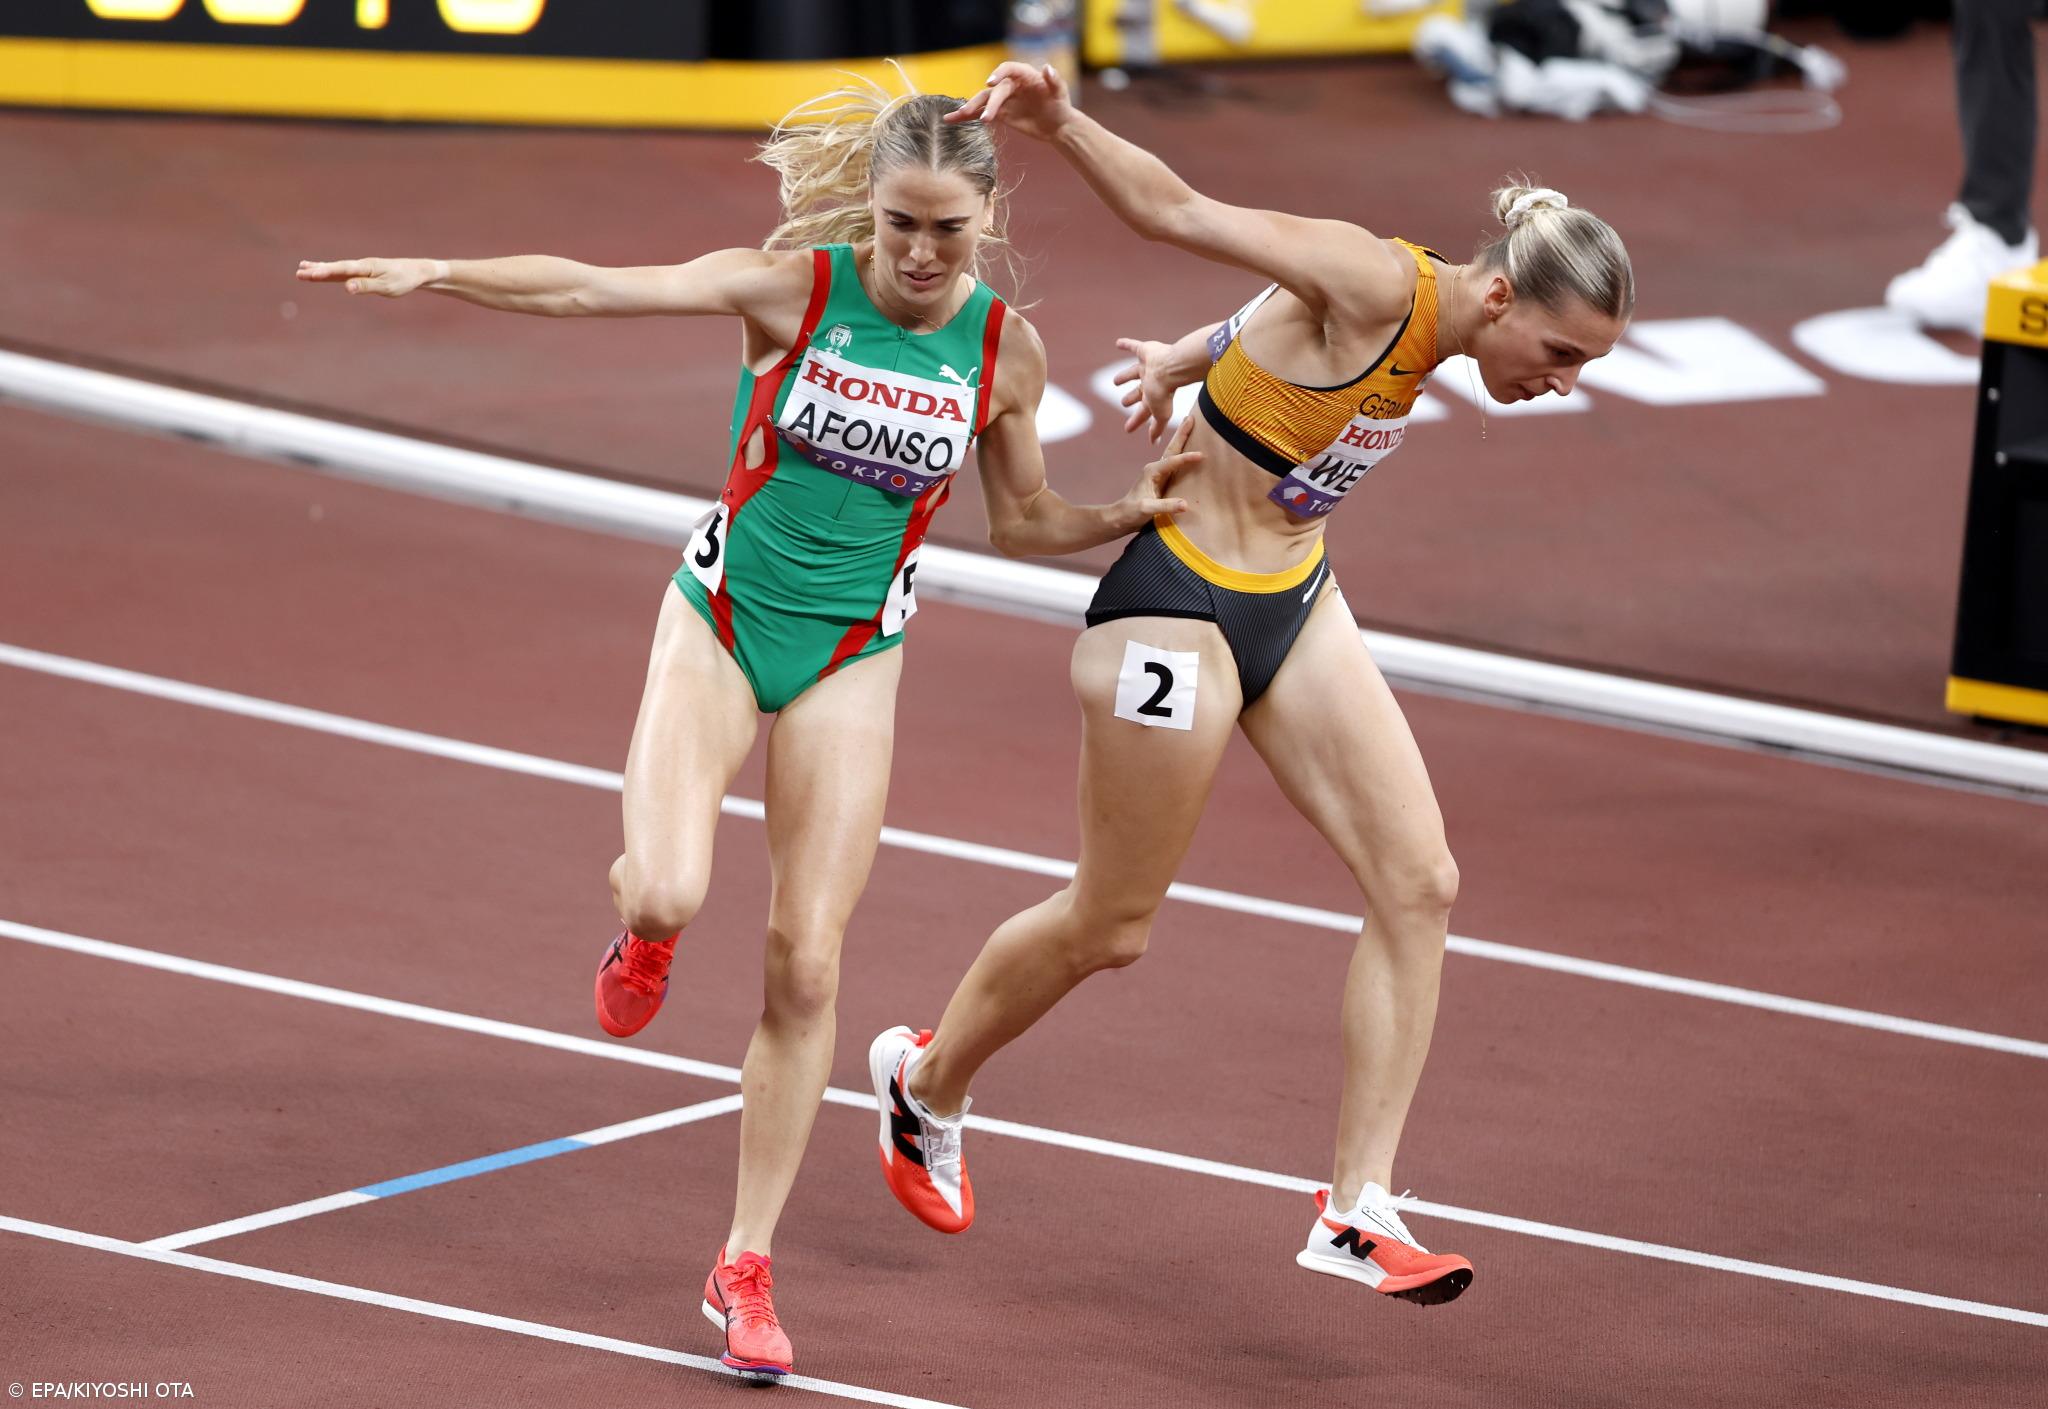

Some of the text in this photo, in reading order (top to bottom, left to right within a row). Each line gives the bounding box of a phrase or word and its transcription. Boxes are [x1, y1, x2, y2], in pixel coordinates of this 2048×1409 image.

[802, 359, 967, 423] HONDA
[787, 401, 953, 472] AFONSO
[1339, 424, 1406, 450] HOND
[1308, 455, 1371, 493] WE
[1137, 661, 1174, 718] 2
